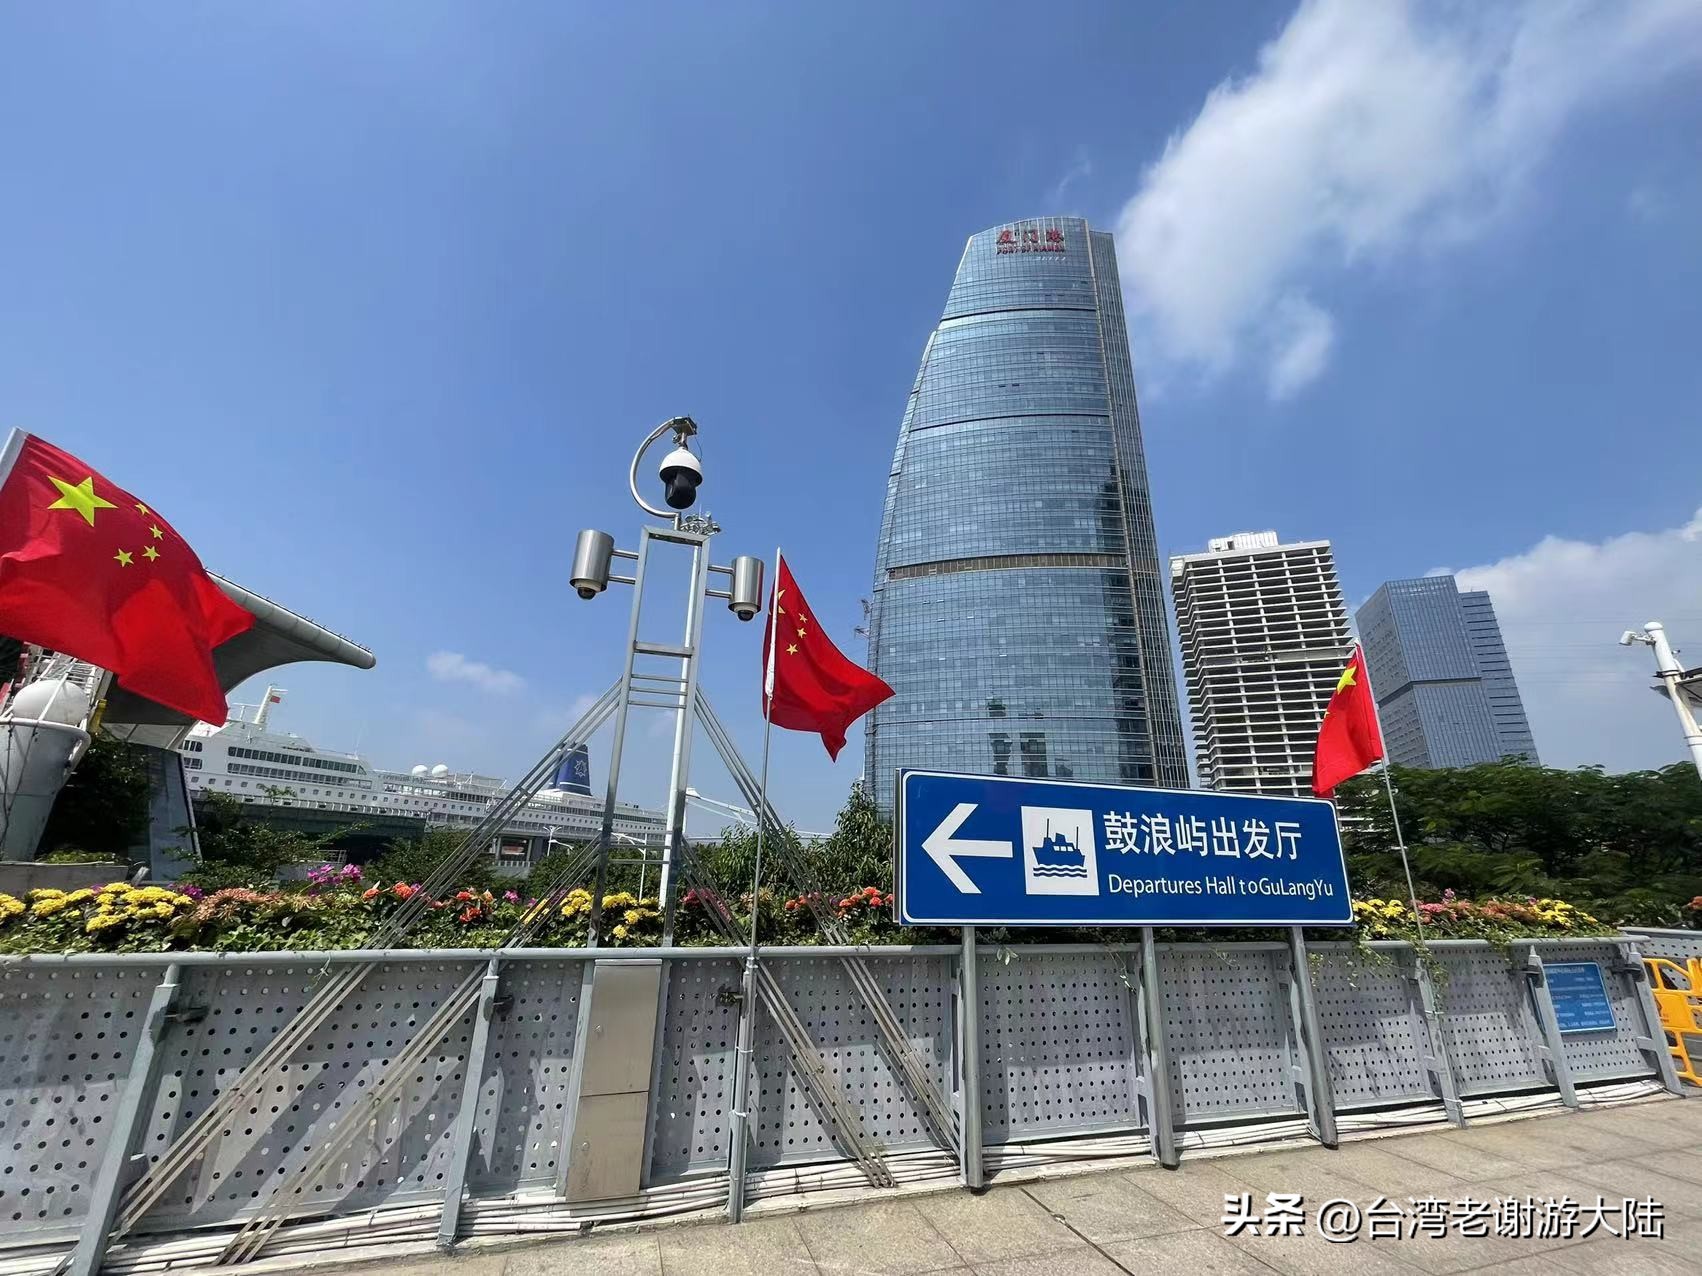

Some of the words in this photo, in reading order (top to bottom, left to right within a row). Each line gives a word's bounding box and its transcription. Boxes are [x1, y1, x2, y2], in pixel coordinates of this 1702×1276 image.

[1102, 810, 1302, 861] 鼓浪屿出发厅
[1108, 873, 1202, 898] Departures
[1205, 875, 1236, 895] Hall
